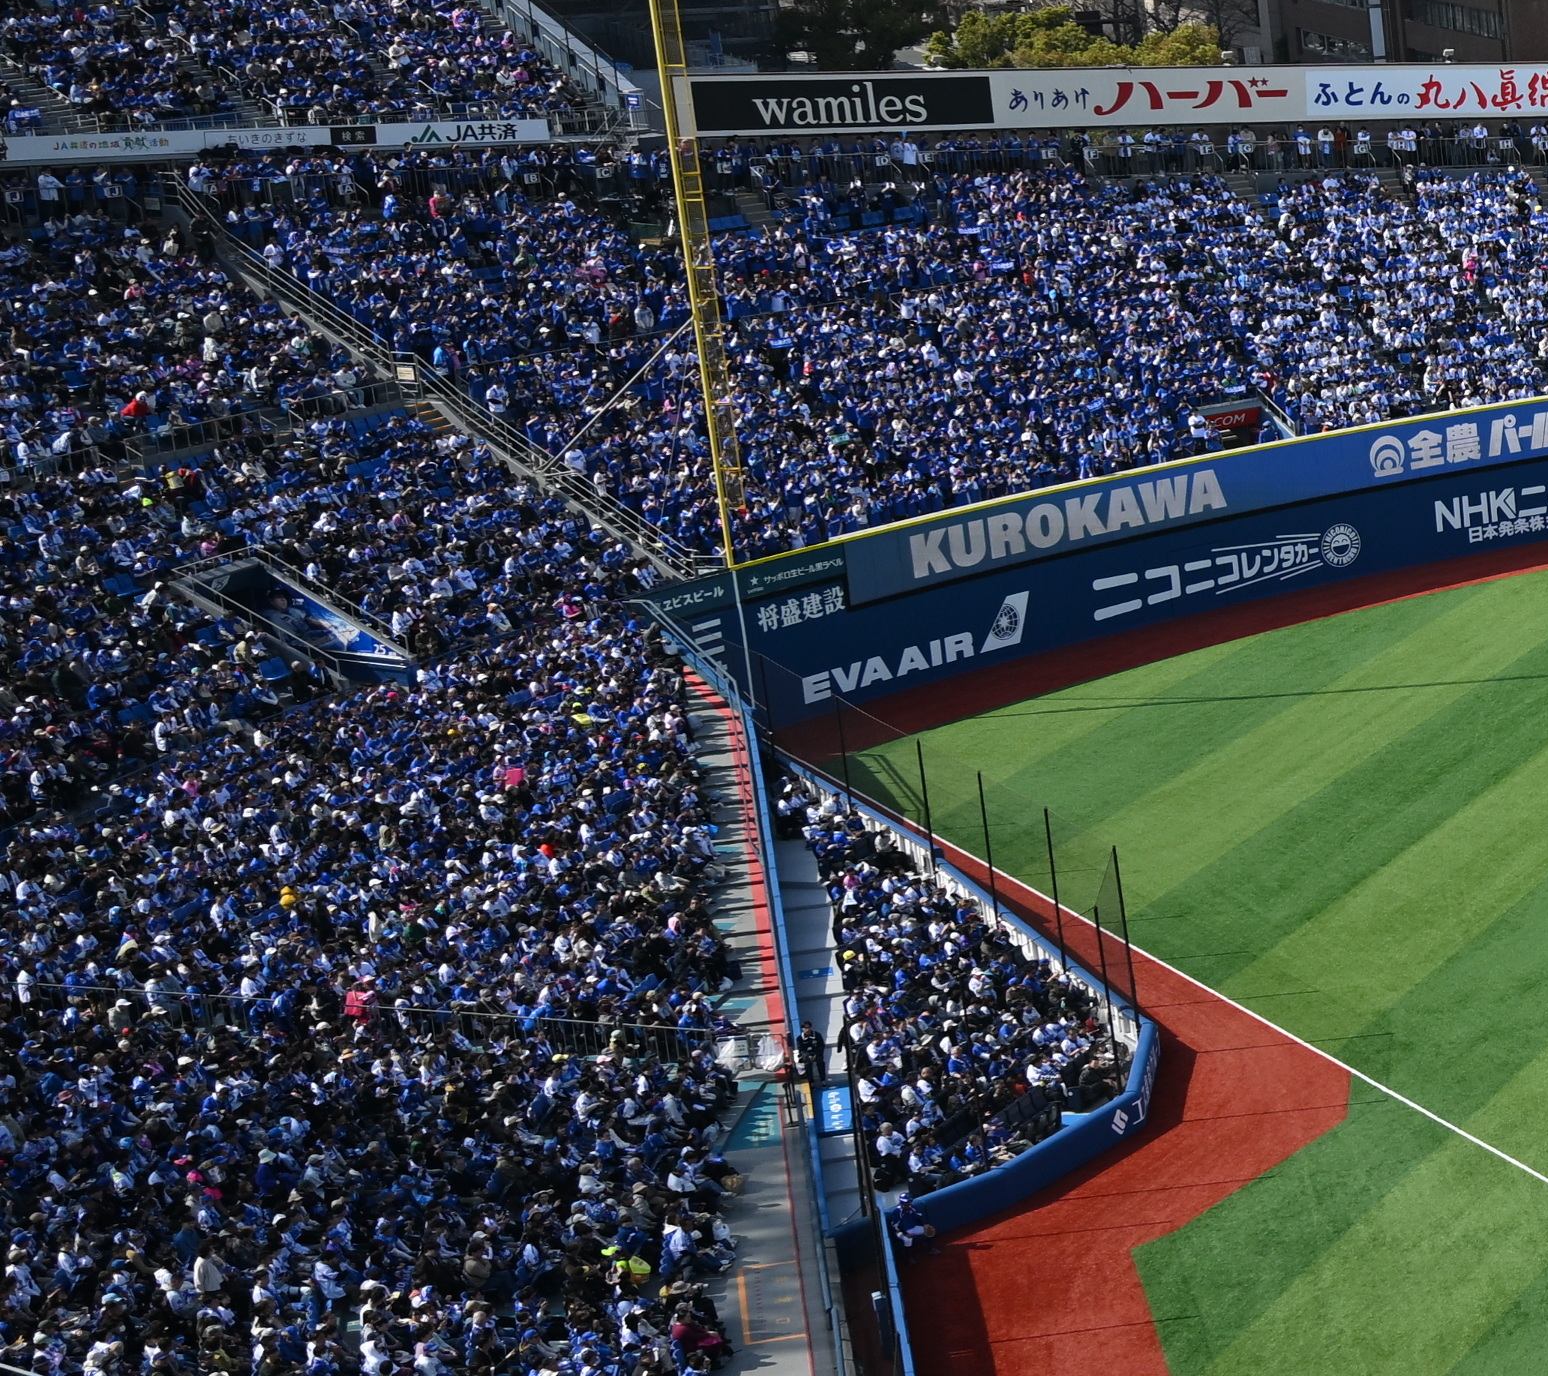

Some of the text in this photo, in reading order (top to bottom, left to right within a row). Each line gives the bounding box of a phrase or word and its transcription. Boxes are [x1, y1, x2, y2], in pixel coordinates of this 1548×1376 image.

[752, 82, 928, 125] wamiles
[1009, 87, 1090, 113] ありあけ
[341, 129, 368, 143] 検索
[446, 122, 518, 142] JA共済
[1408, 424, 1481, 466] 全農
[910, 468, 1229, 580] KUROKAWA
[763, 556, 844, 585] サッポロ生ビール黒ラベル
[1094, 536, 1321, 622] ニコニコレンタカー
[756, 585, 847, 633] 将盛建設
[801, 631, 975, 705] EVA AIR
